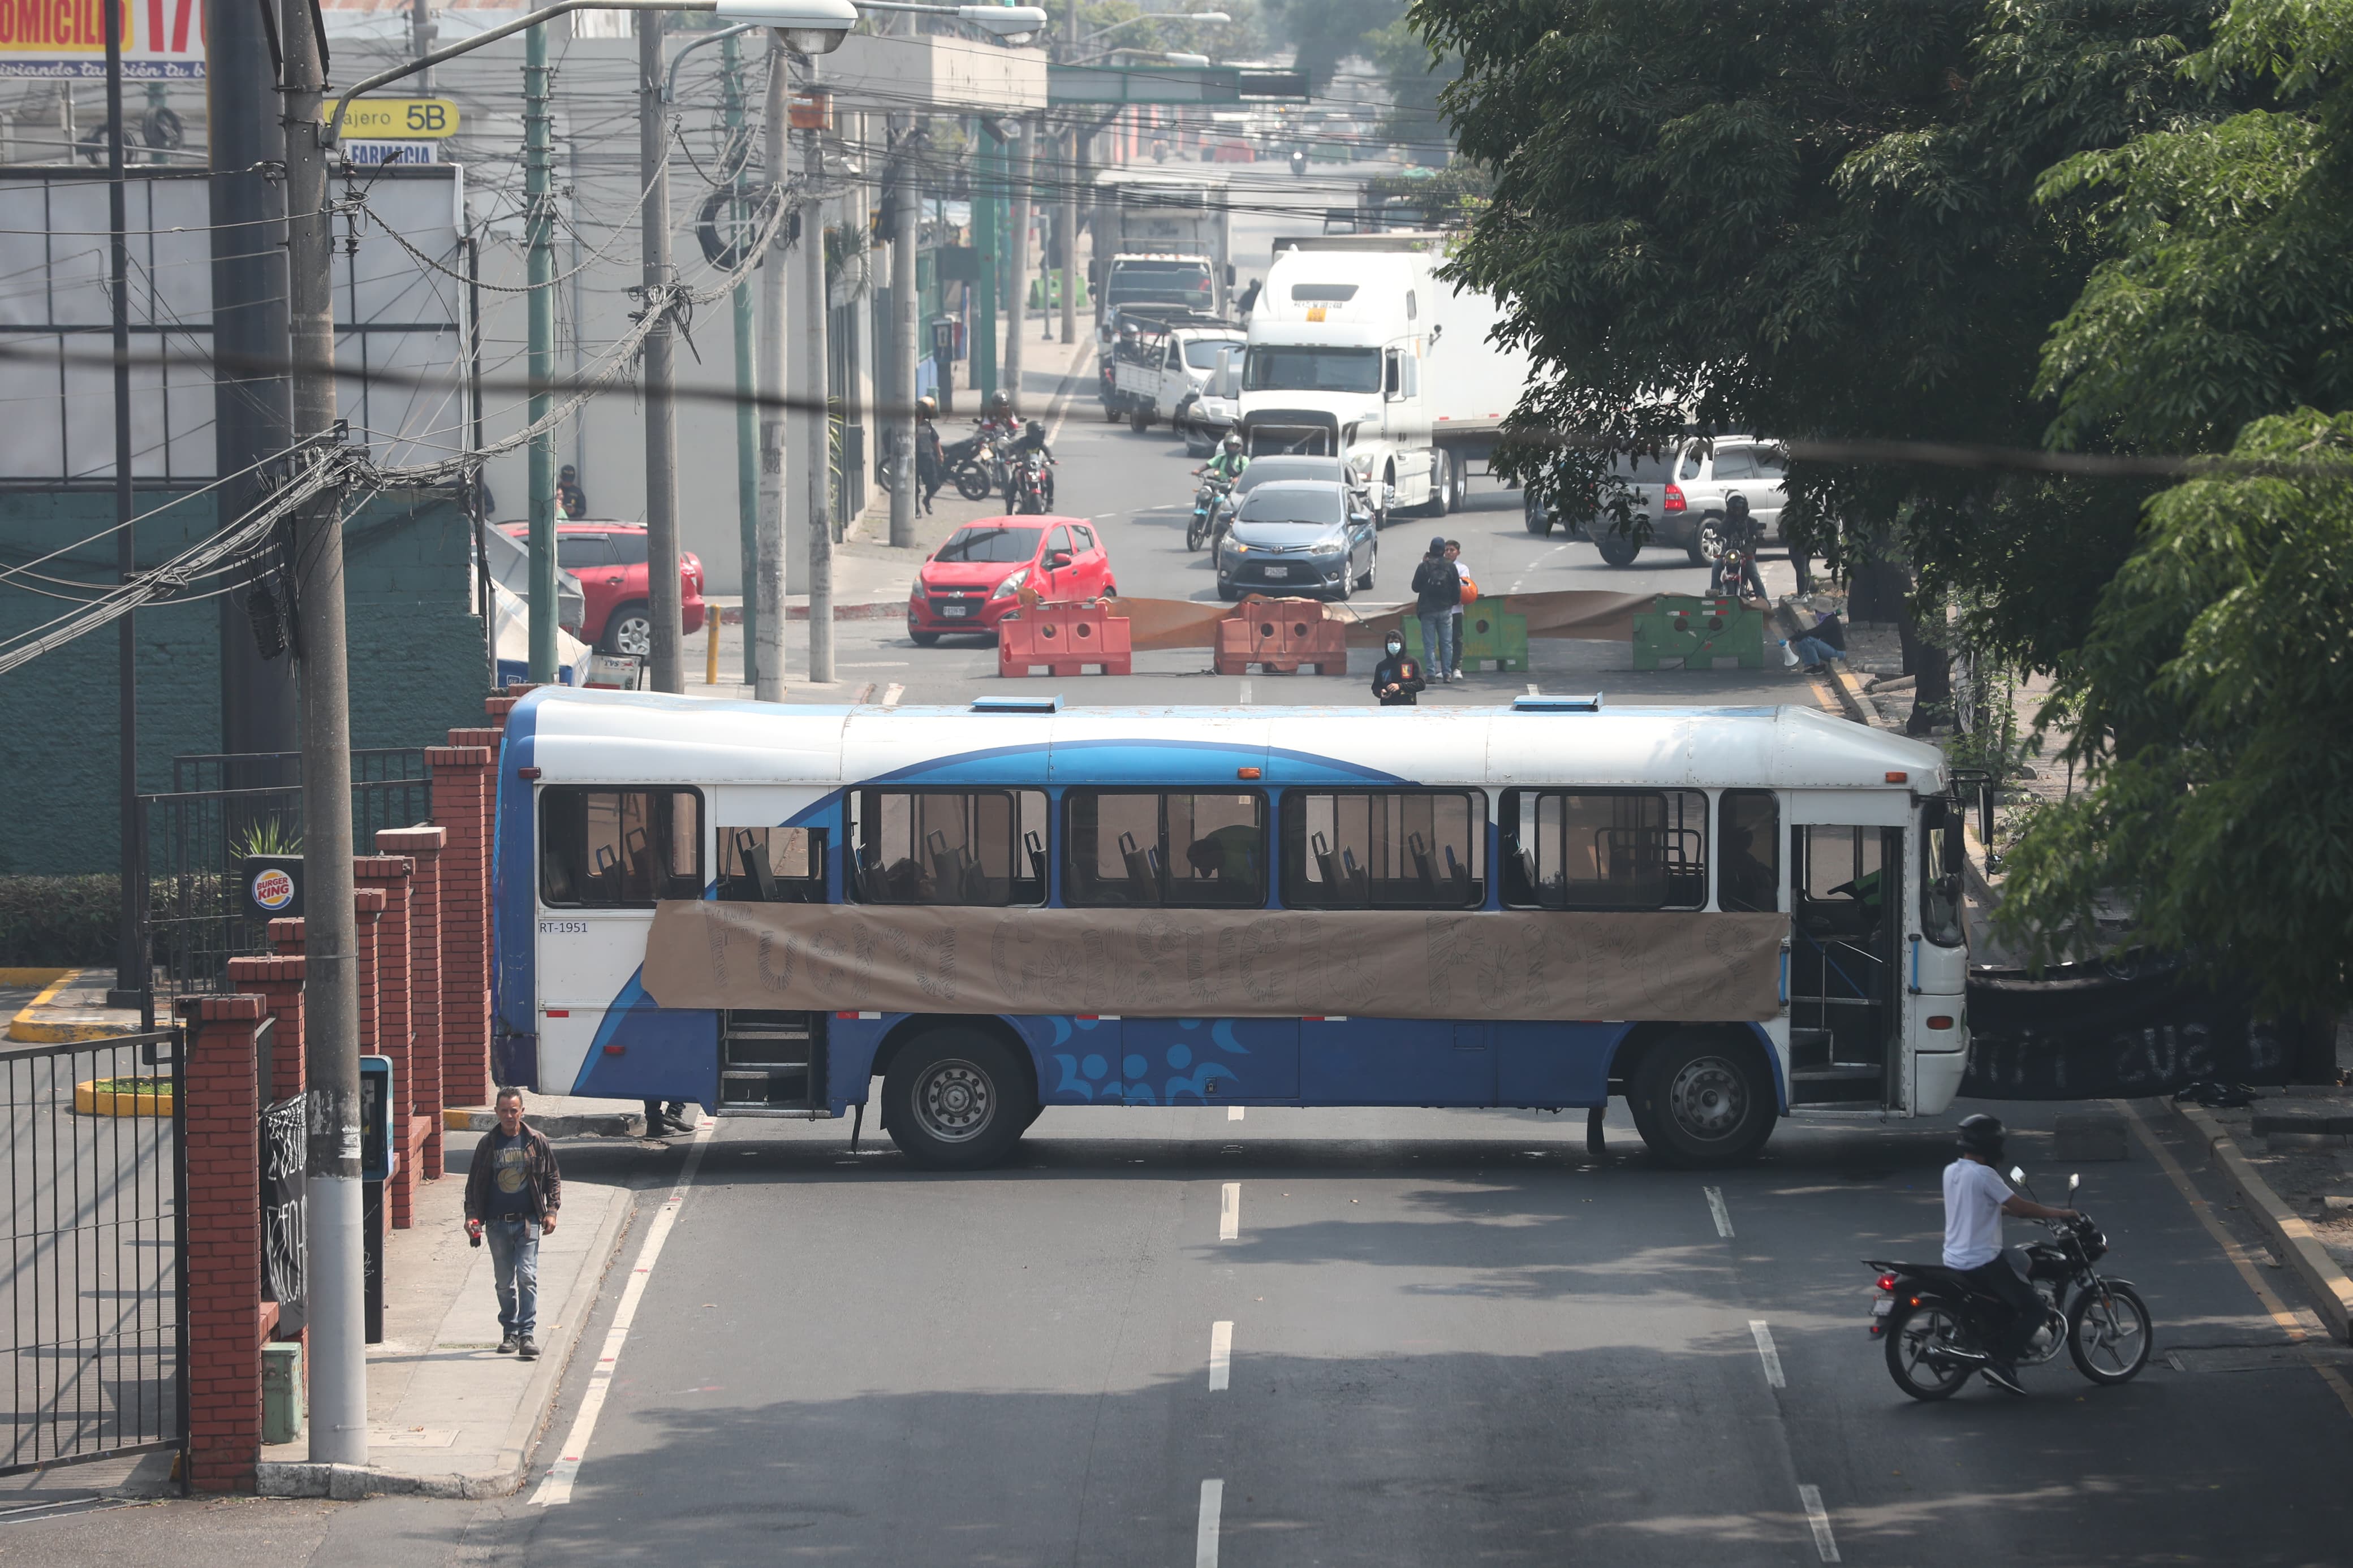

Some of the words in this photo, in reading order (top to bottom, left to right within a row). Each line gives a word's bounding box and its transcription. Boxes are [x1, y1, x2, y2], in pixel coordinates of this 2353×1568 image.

[163, 62, 189, 77] tu
[407, 105, 446, 130] 5B
[351, 145, 430, 163] FARMACIA
[257, 877, 288, 891] BURGER
[257, 884, 289, 901] KING
[540, 922, 588, 933] RT-1951
